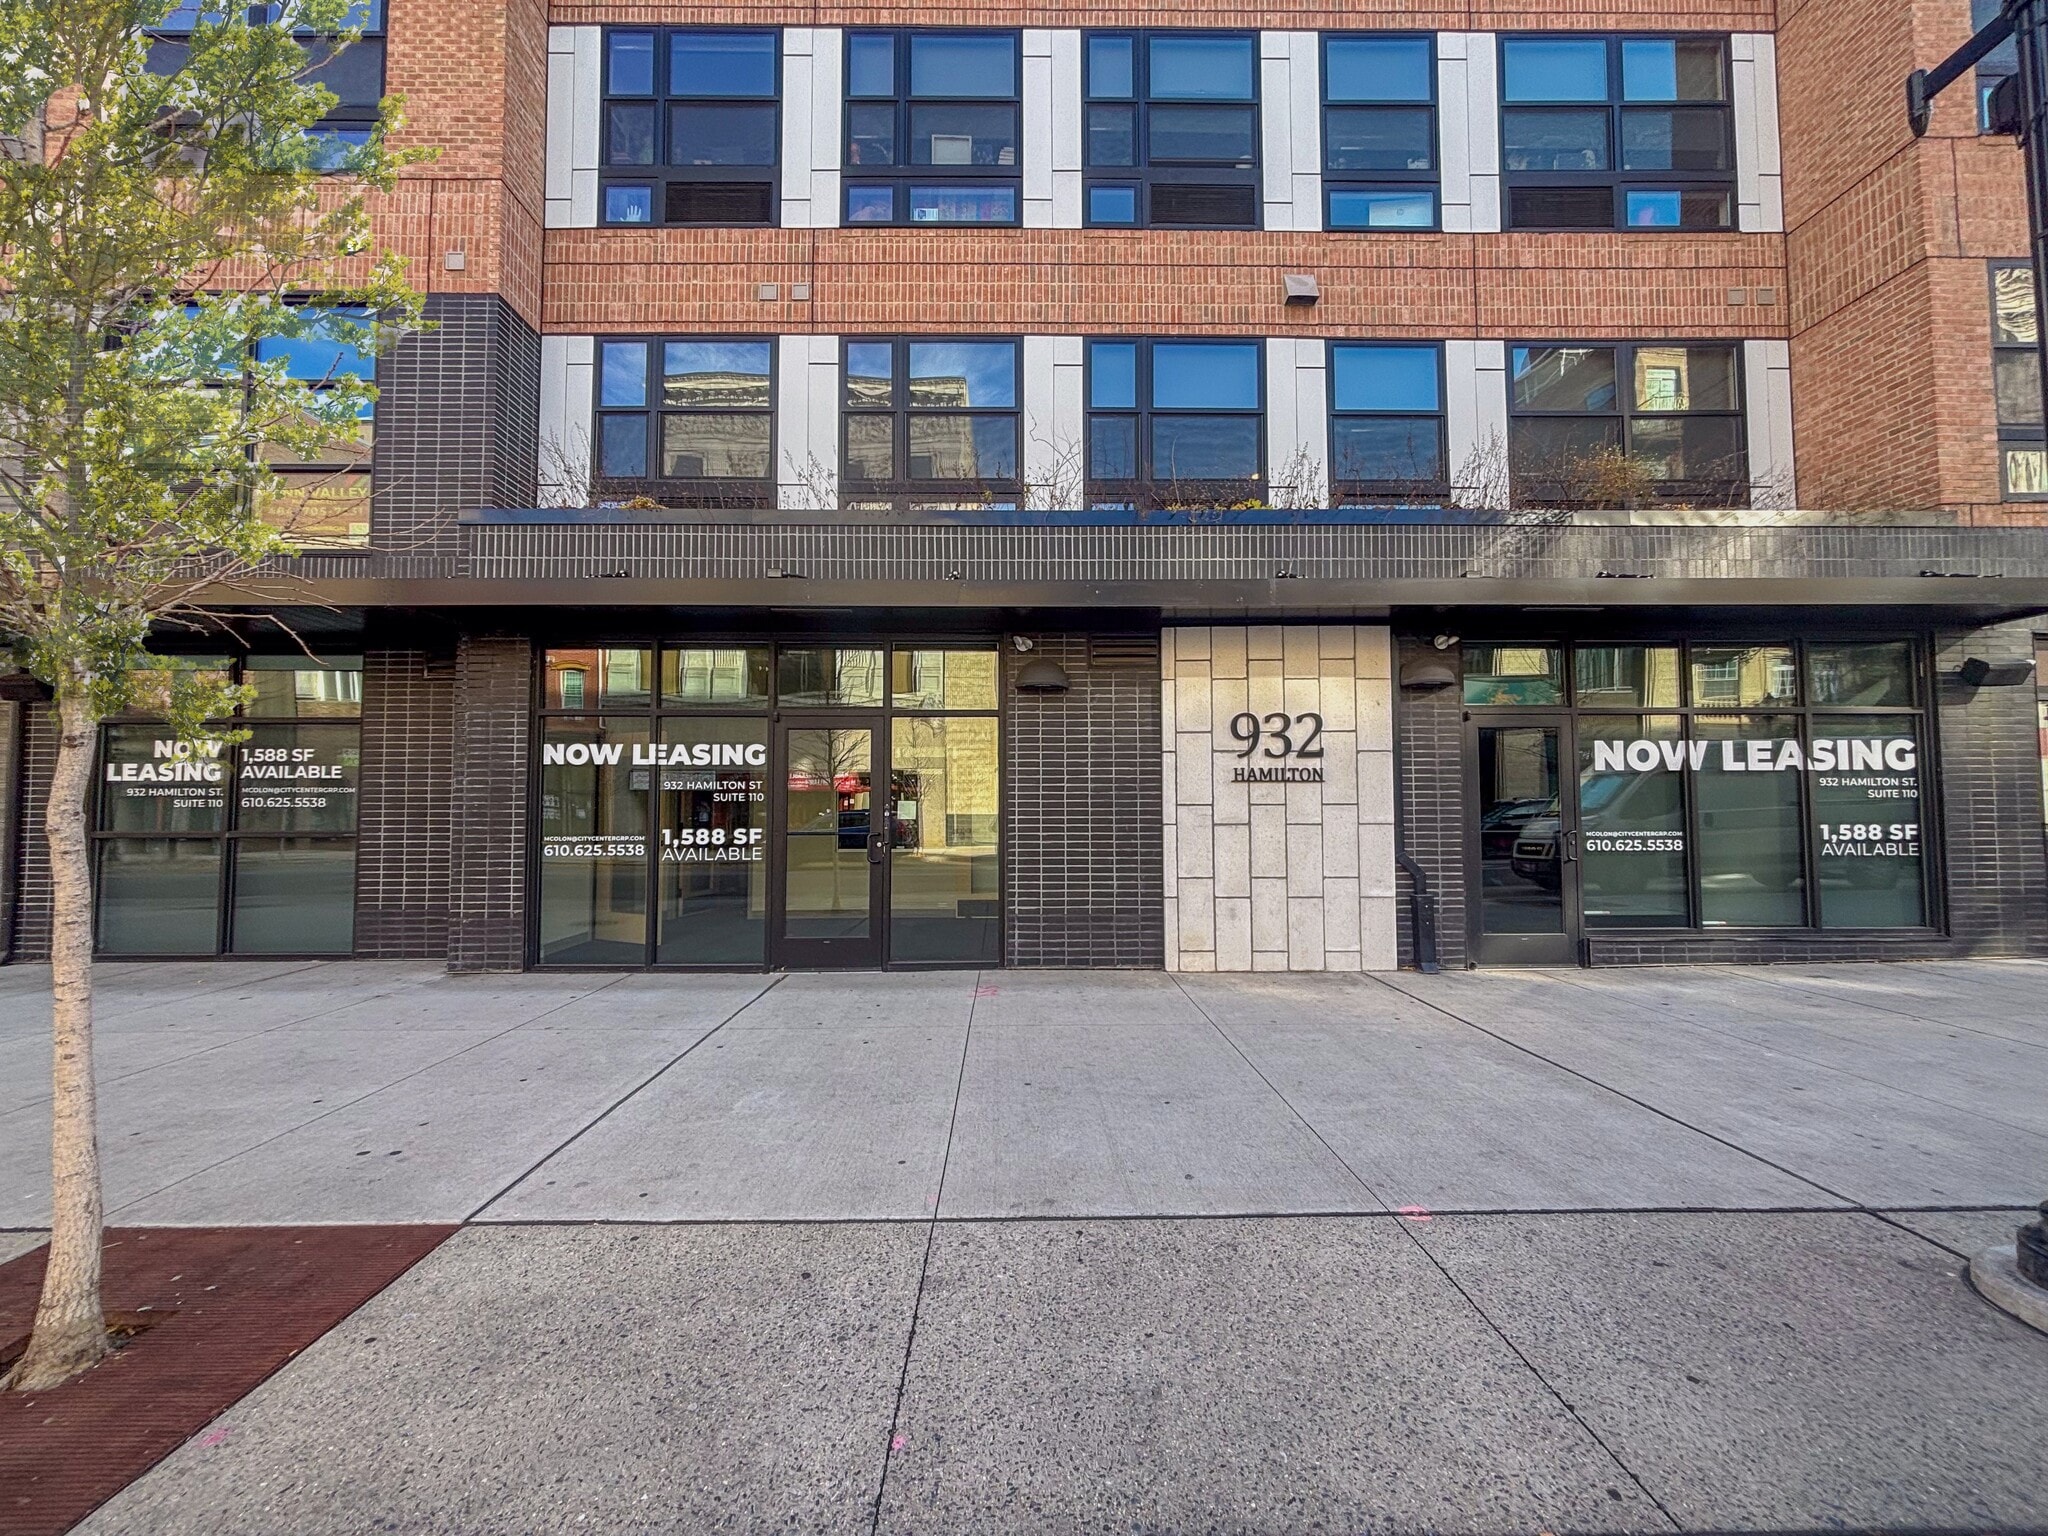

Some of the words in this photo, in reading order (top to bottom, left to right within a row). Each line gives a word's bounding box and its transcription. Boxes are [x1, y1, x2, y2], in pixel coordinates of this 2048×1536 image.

[312, 487, 368, 498] VALLEY
[1230, 712, 1324, 759] 932
[241, 749, 288, 764] 1,588
[291, 748, 316, 762] SF
[543, 744, 624, 765] NOW
[632, 744, 766, 765] LEASING
[1593, 740, 1709, 771] NOW
[1721, 740, 1917, 771] LEASING
[106, 763, 222, 781] LEASING
[239, 765, 343, 779] AVAILABLE
[1232, 767, 1324, 783] HAMILTON
[663, 780, 684, 790] 932
[686, 780, 746, 790] HAMILTON
[748, 780, 763, 790] ST
[1818, 777, 1840, 787] 932
[1841, 777, 1900, 787] HAMILTON
[1901, 777, 1918, 787] ST.
[126, 787, 147, 797] 932
[148, 787, 206, 797] HAMILTON
[207, 787, 224, 797] ST.
[713, 792, 746, 802] SUITE
[748, 792, 765, 802] 110
[1867, 789, 1900, 799] SUITE
[1901, 789, 1918, 798] 110
[173, 799, 206, 808] SUITE
[207, 799, 224, 808] 110
[241, 797, 327, 808] 610.625.5538
[661, 829, 726, 847] 1,588
[733, 829, 763, 844] SF
[1819, 824, 1884, 842] 1,588
[1889, 824, 1918, 840] SF
[543, 843, 645, 857] 610.625.5538
[1586, 839, 1684, 852] 610.625.5538
[1821, 843, 1920, 856] AVAILABLE
[661, 848, 763, 861] AVAILABLE
